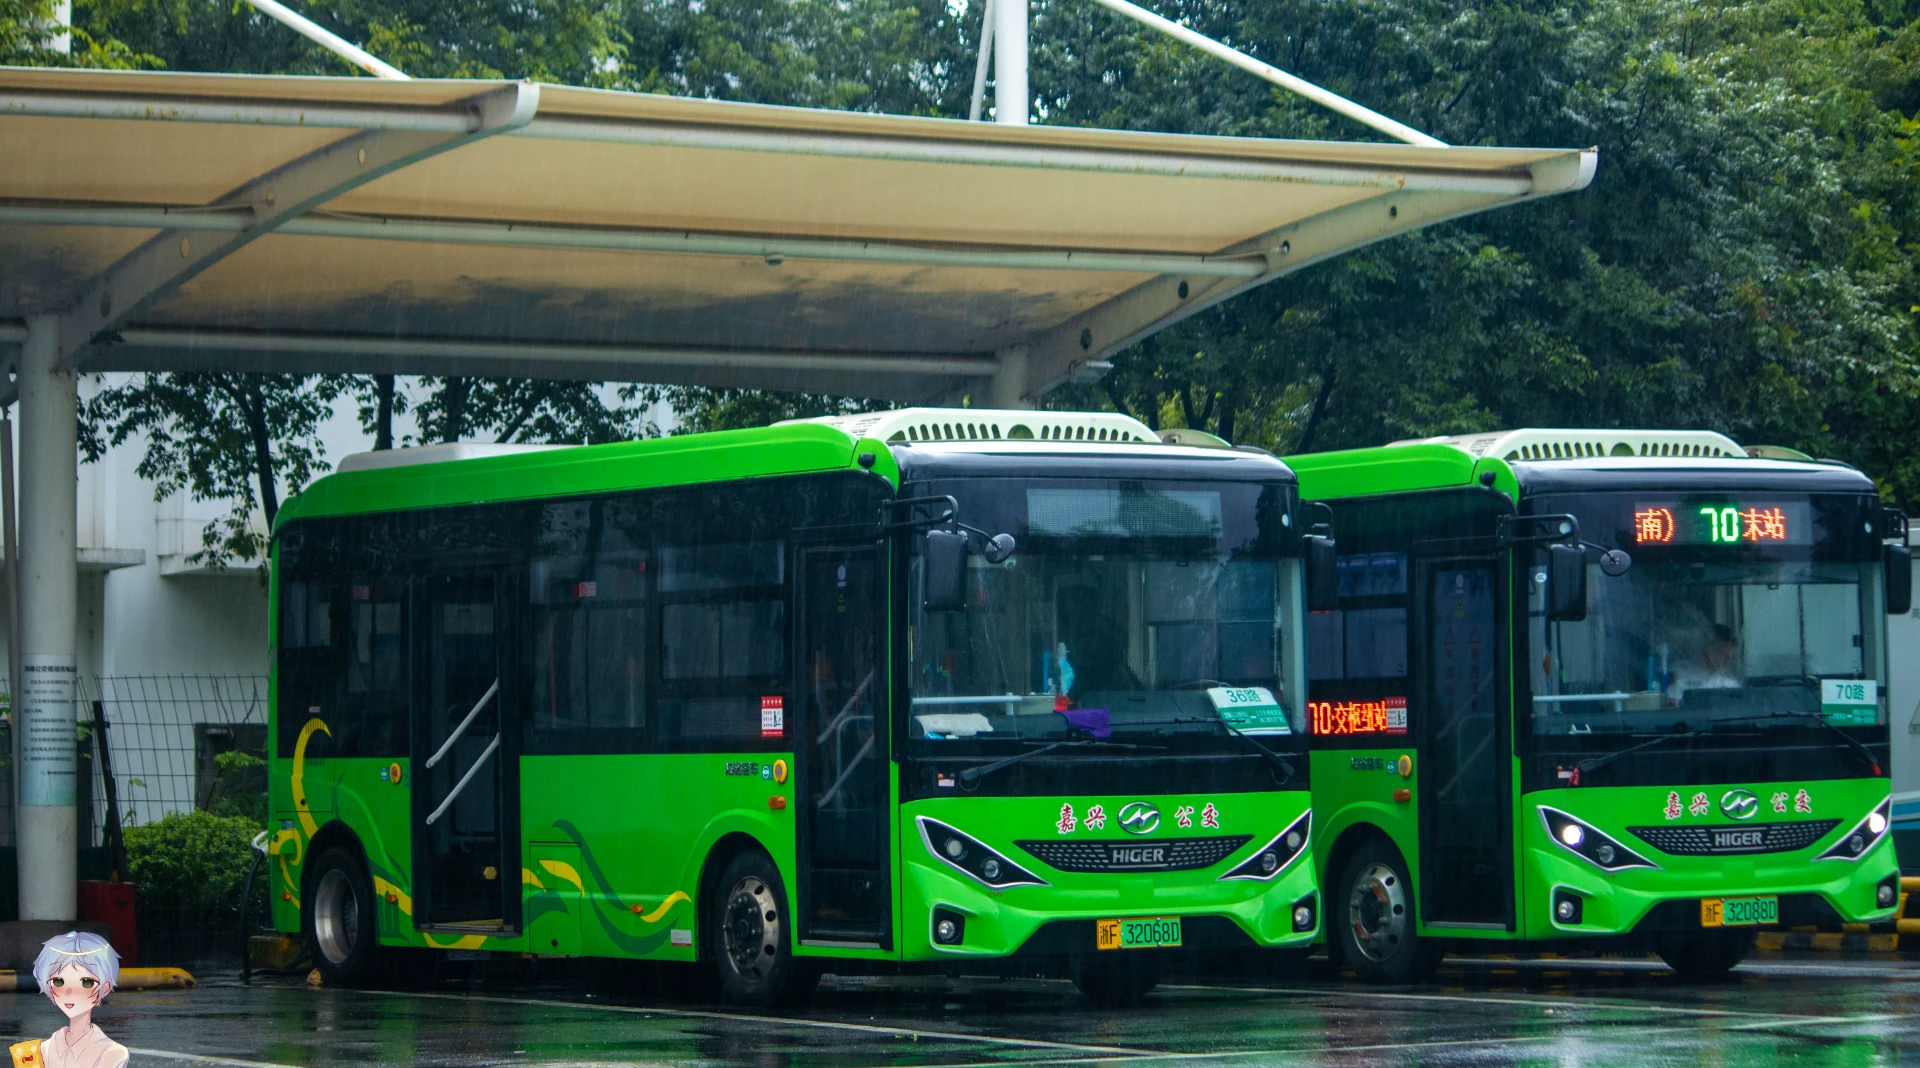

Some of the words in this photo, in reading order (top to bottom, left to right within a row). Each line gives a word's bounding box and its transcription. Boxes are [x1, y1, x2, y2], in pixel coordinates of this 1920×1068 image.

[1226, 689, 1261, 702] 36路
[1836, 684, 1864, 700] 70路
[1664, 791, 1709, 820] 嘉兴
[1770, 789, 1811, 813] 公交
[1056, 803, 1106, 834] 嘉兴
[1174, 802, 1219, 829] 公交
[1714, 832, 1763, 846] HIGER
[1112, 849, 1164, 863] HIGER
[1126, 922, 1180, 944] 32068D
